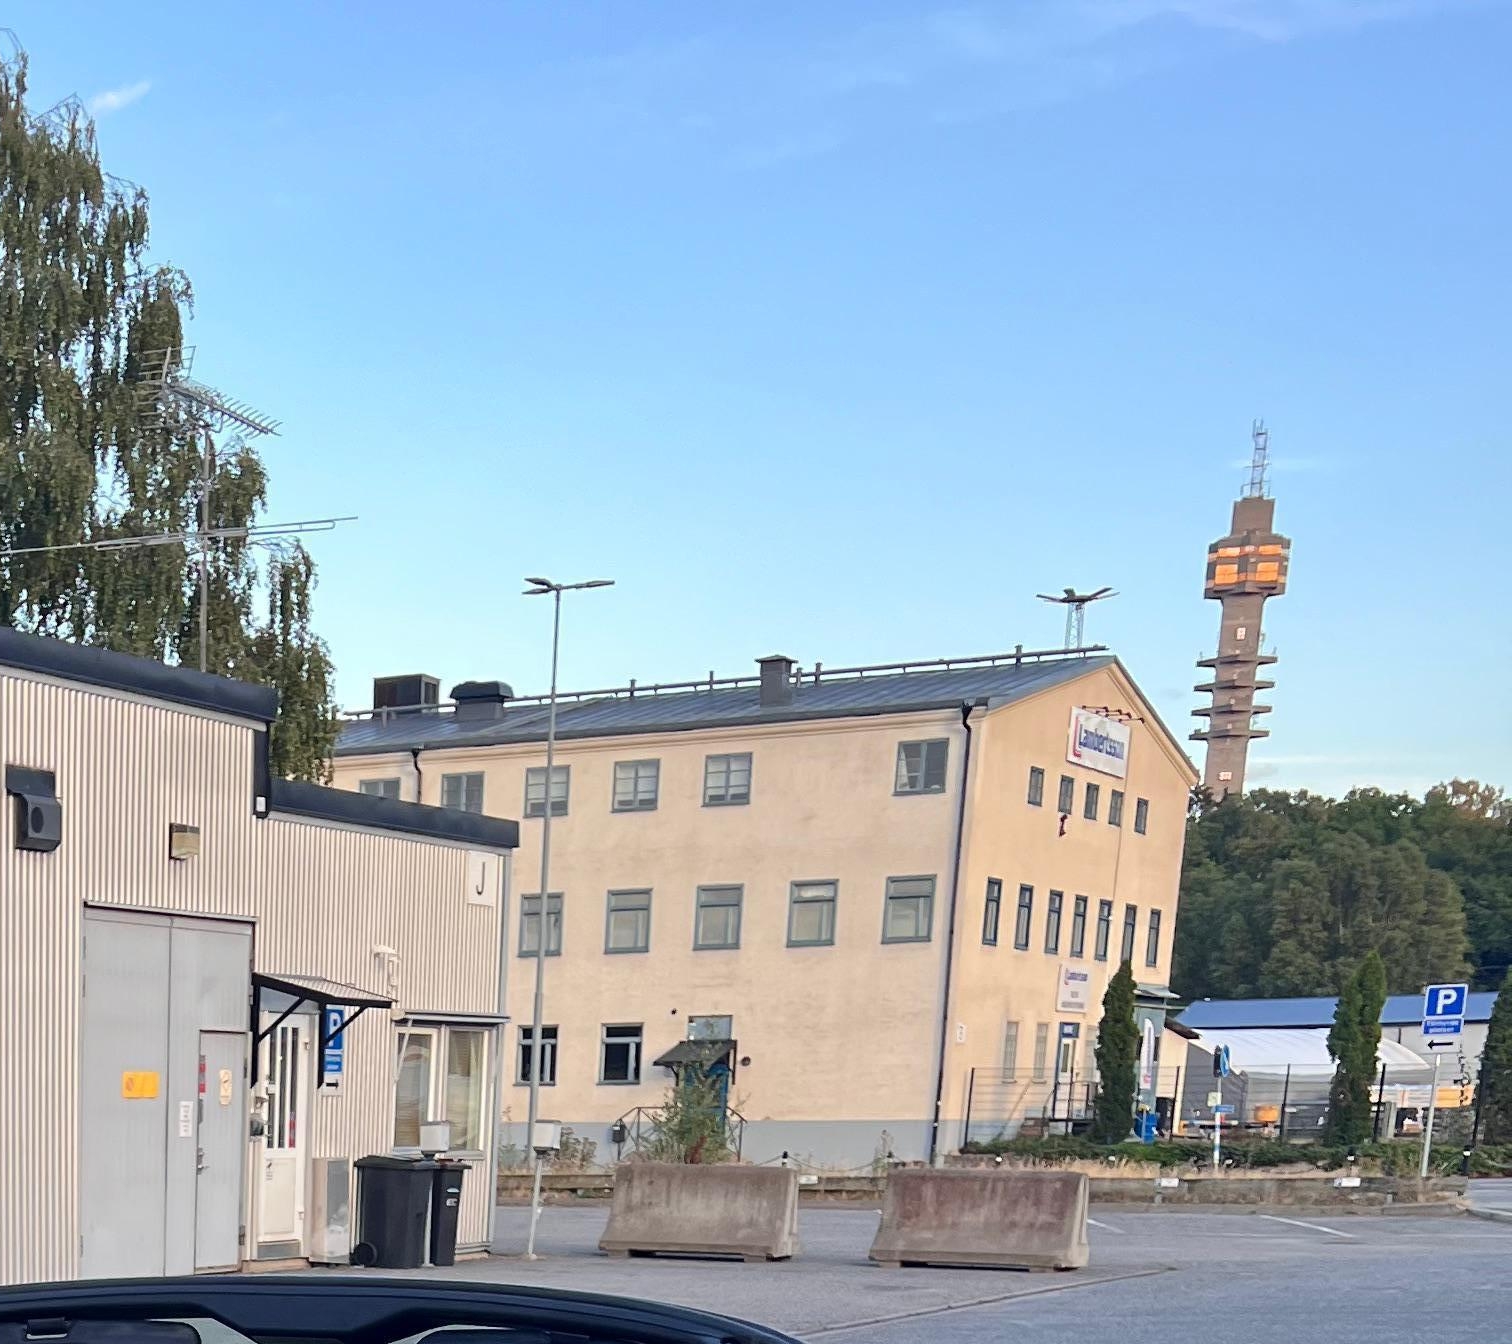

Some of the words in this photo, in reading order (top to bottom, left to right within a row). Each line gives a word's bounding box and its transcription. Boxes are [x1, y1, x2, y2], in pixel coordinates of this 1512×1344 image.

[476, 861, 486, 896] J
[1436, 989, 1458, 1015] P
[328, 1012, 342, 1047] P
